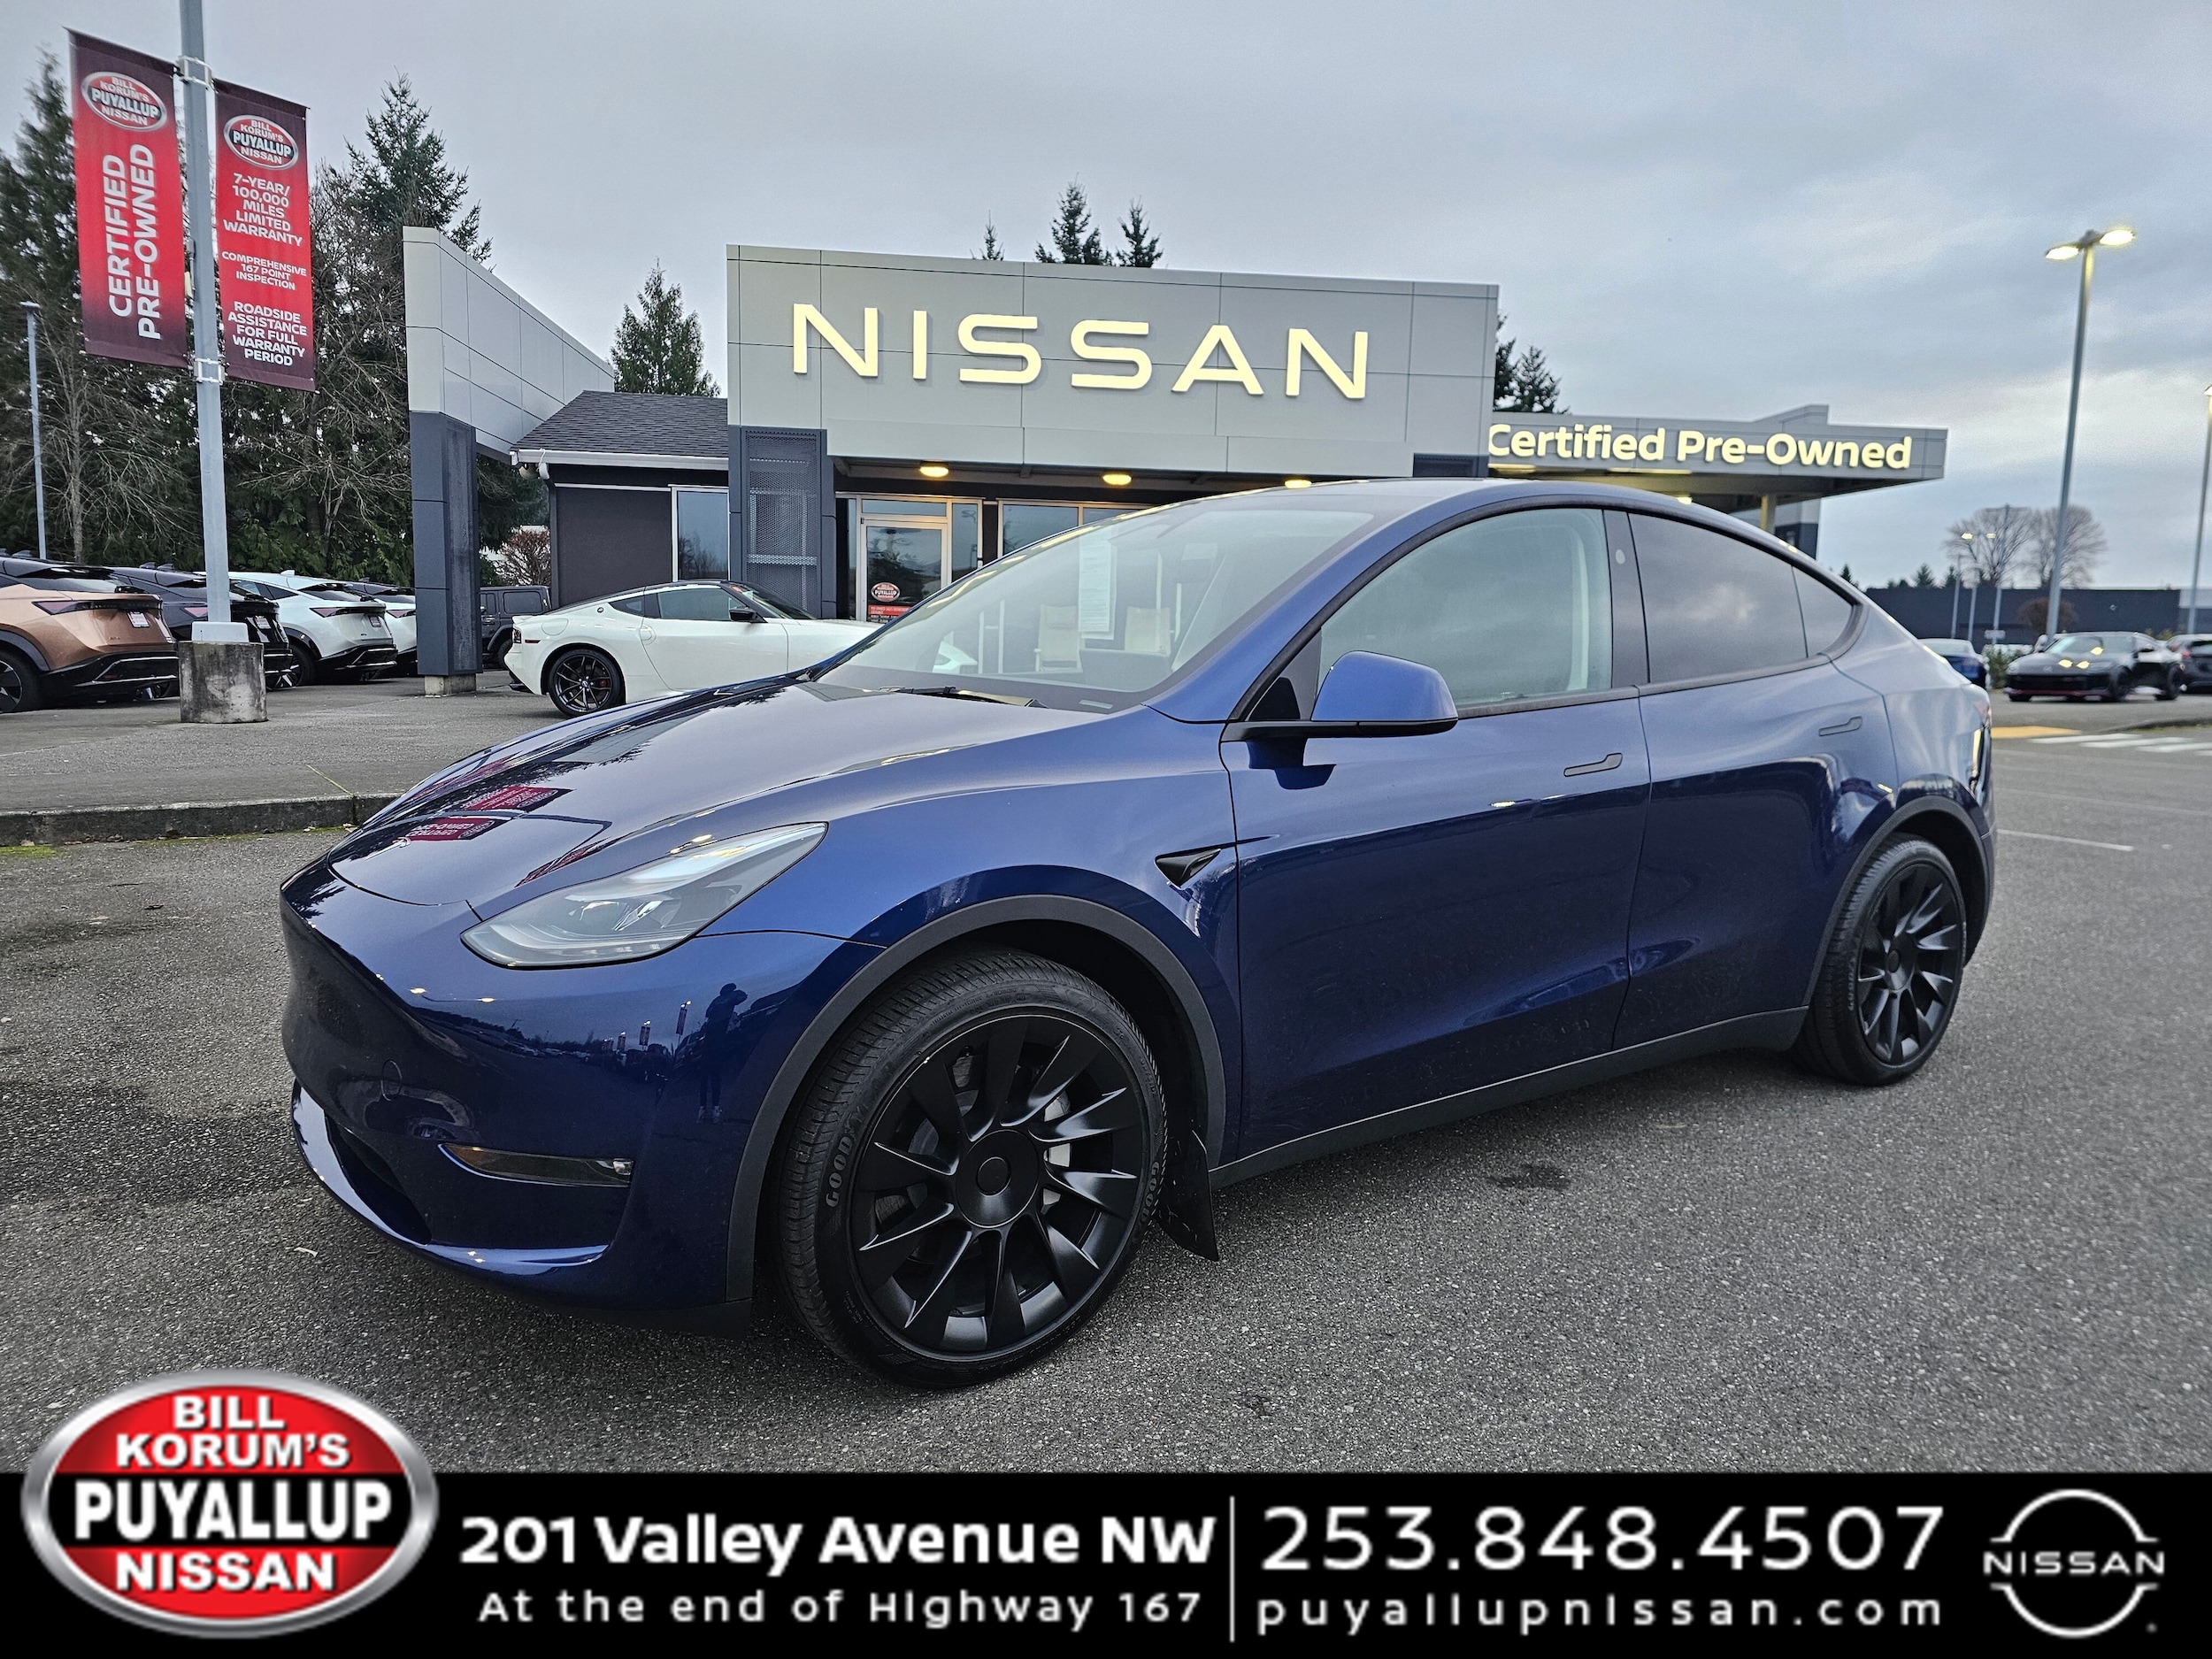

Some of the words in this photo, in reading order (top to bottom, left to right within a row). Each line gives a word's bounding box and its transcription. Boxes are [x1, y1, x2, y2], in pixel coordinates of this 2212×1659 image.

[100, 81, 150, 102] KORUM'S
[111, 76, 135, 89] BILL
[91, 88, 159, 118] PUYALLUP
[101, 105, 148, 126] NISSAN
[250, 119, 272, 132] BILL
[233, 131, 291, 157] PUYALLUP
[241, 124, 284, 142] KORUM'S
[241, 148, 282, 165] NISSAN
[234, 173, 290, 196] 7-YEAR/
[232, 185, 289, 208] 100,000
[242, 200, 285, 219] MILES
[235, 211, 291, 232] LIMITED
[103, 154, 132, 318] CERTIFIED
[130, 143, 161, 340] PRE-OWNED
[223, 219, 303, 247] WARRANTY
[221, 251, 307, 276] COMPREHENSIVE
[241, 264, 259, 273] 167
[261, 267, 291, 280] POINT
[235, 271, 296, 290] INSPECTION
[228, 311, 307, 335] ASSISTANCE
[234, 301, 301, 323] ROADSIDE
[233, 334, 305, 357] WARRANTY
[236, 324, 265, 339] FOR
[267, 329, 298, 345] FULL
[244, 348, 293, 366] PERIOD
[792, 303, 1369, 400] NISSAN
[1488, 423, 1665, 461] Certified
[1676, 429, 1912, 470] Pre-Owned
